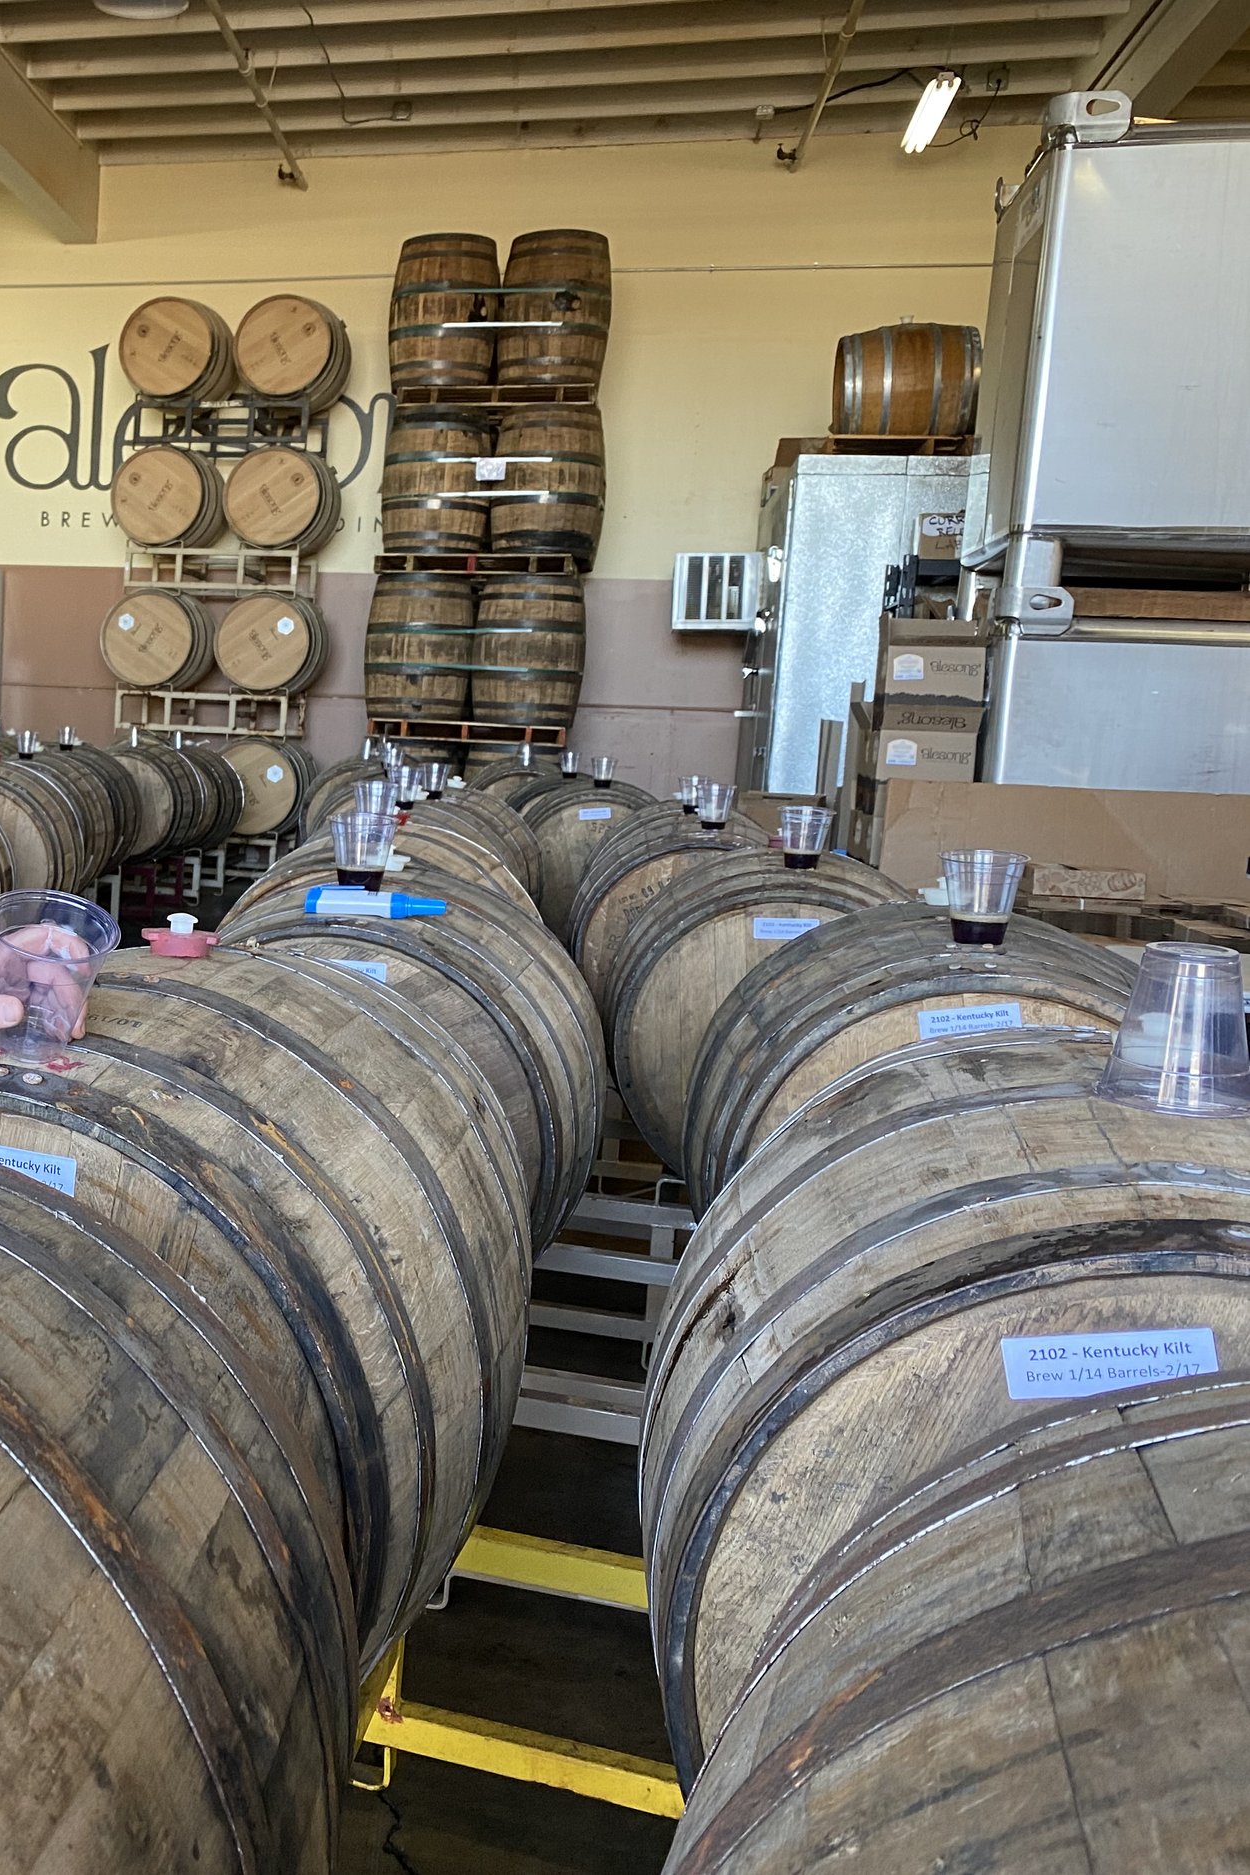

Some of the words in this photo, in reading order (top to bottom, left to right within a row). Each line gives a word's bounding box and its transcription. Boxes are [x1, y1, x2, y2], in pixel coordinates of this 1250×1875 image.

[931, 1015, 950, 1024] 2102
[956, 1011, 994, 1022] Kentucky
[43, 1163, 61, 1176] Kilt
[1028, 1348, 1068, 1362] 2102
[1082, 1341, 1159, 1360] Kentucky
[1163, 1341, 1192, 1355] Kilt
[1026, 1369, 1063, 1383] Brew
[1069, 1366, 1102, 1382] 1/14
[1108, 1361, 1201, 1379] Barrels-2/17
